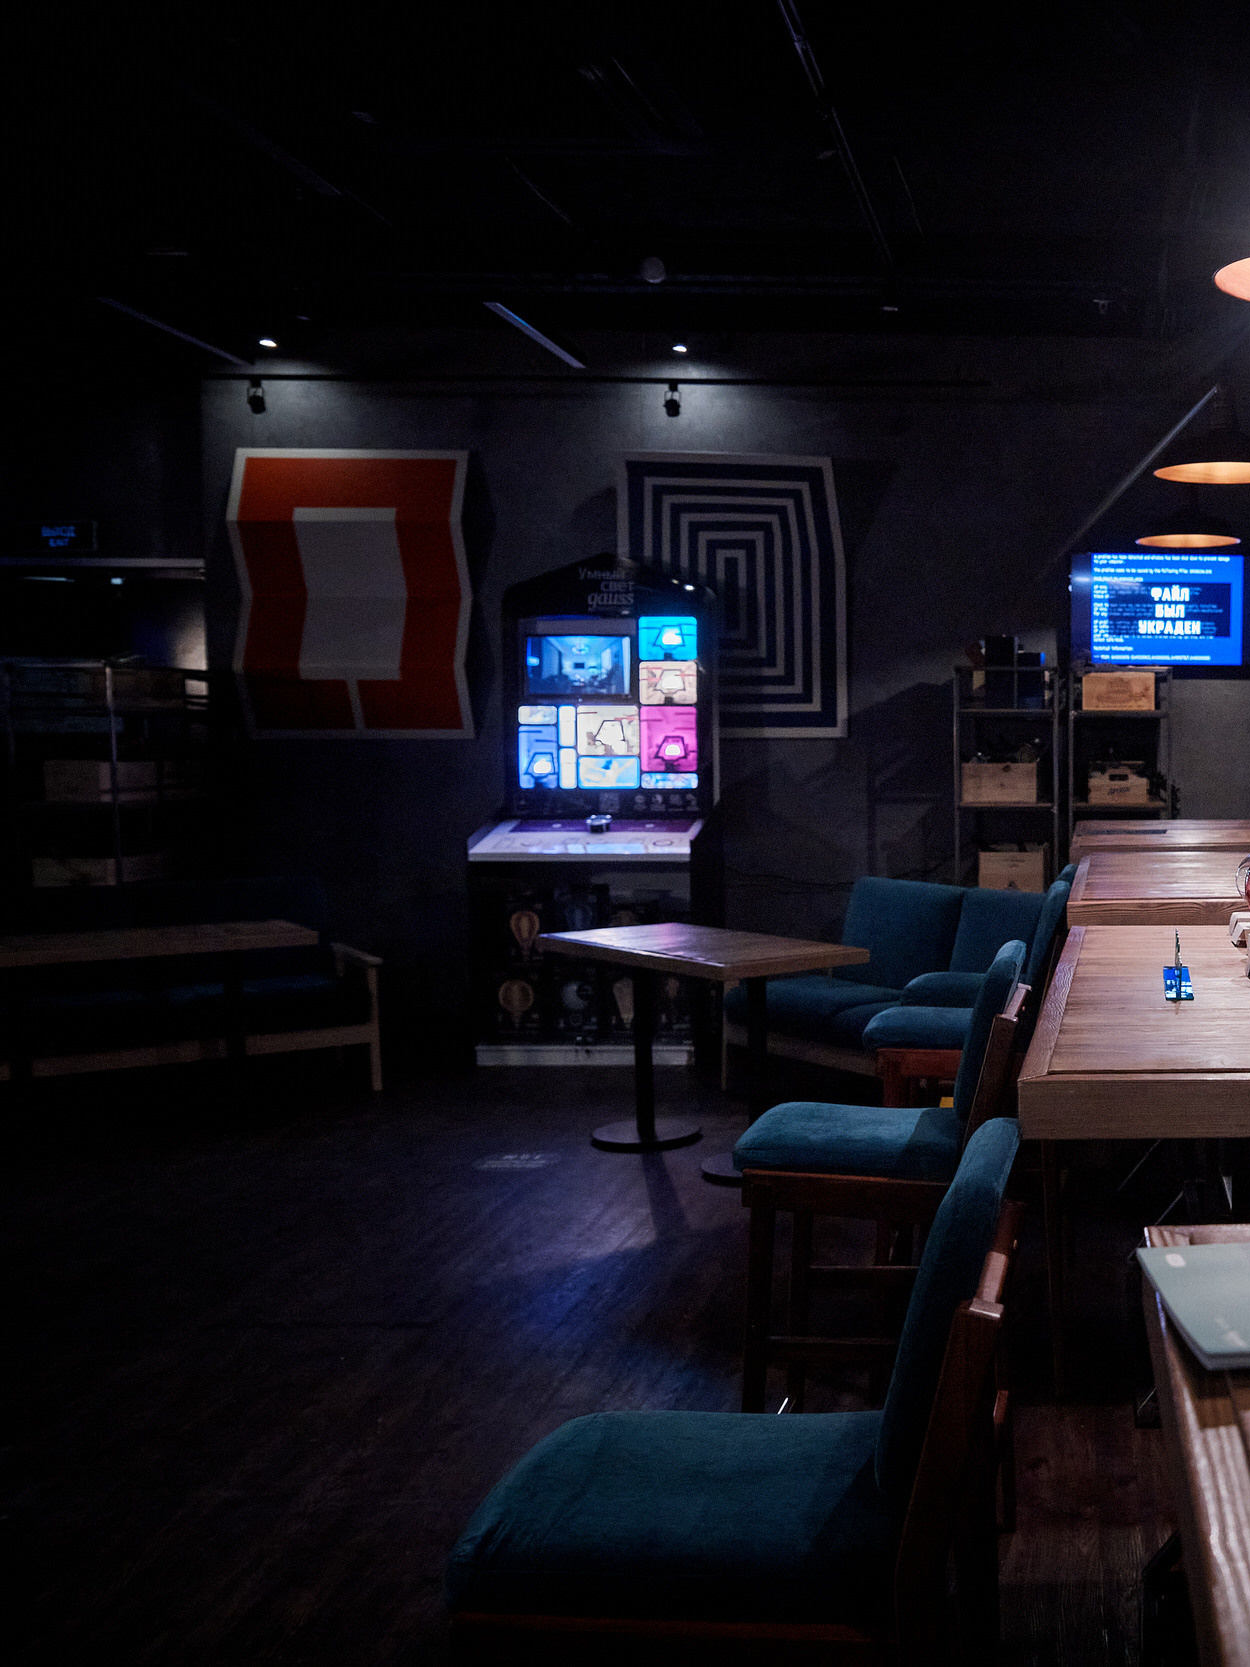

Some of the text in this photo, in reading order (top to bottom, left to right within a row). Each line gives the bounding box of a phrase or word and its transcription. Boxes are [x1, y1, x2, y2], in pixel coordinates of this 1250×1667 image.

[1150, 585, 1190, 601] ФАЙЛ
[1154, 604, 1186, 618] БЫЛ
[1138, 620, 1201, 635] УКРАДЕН
